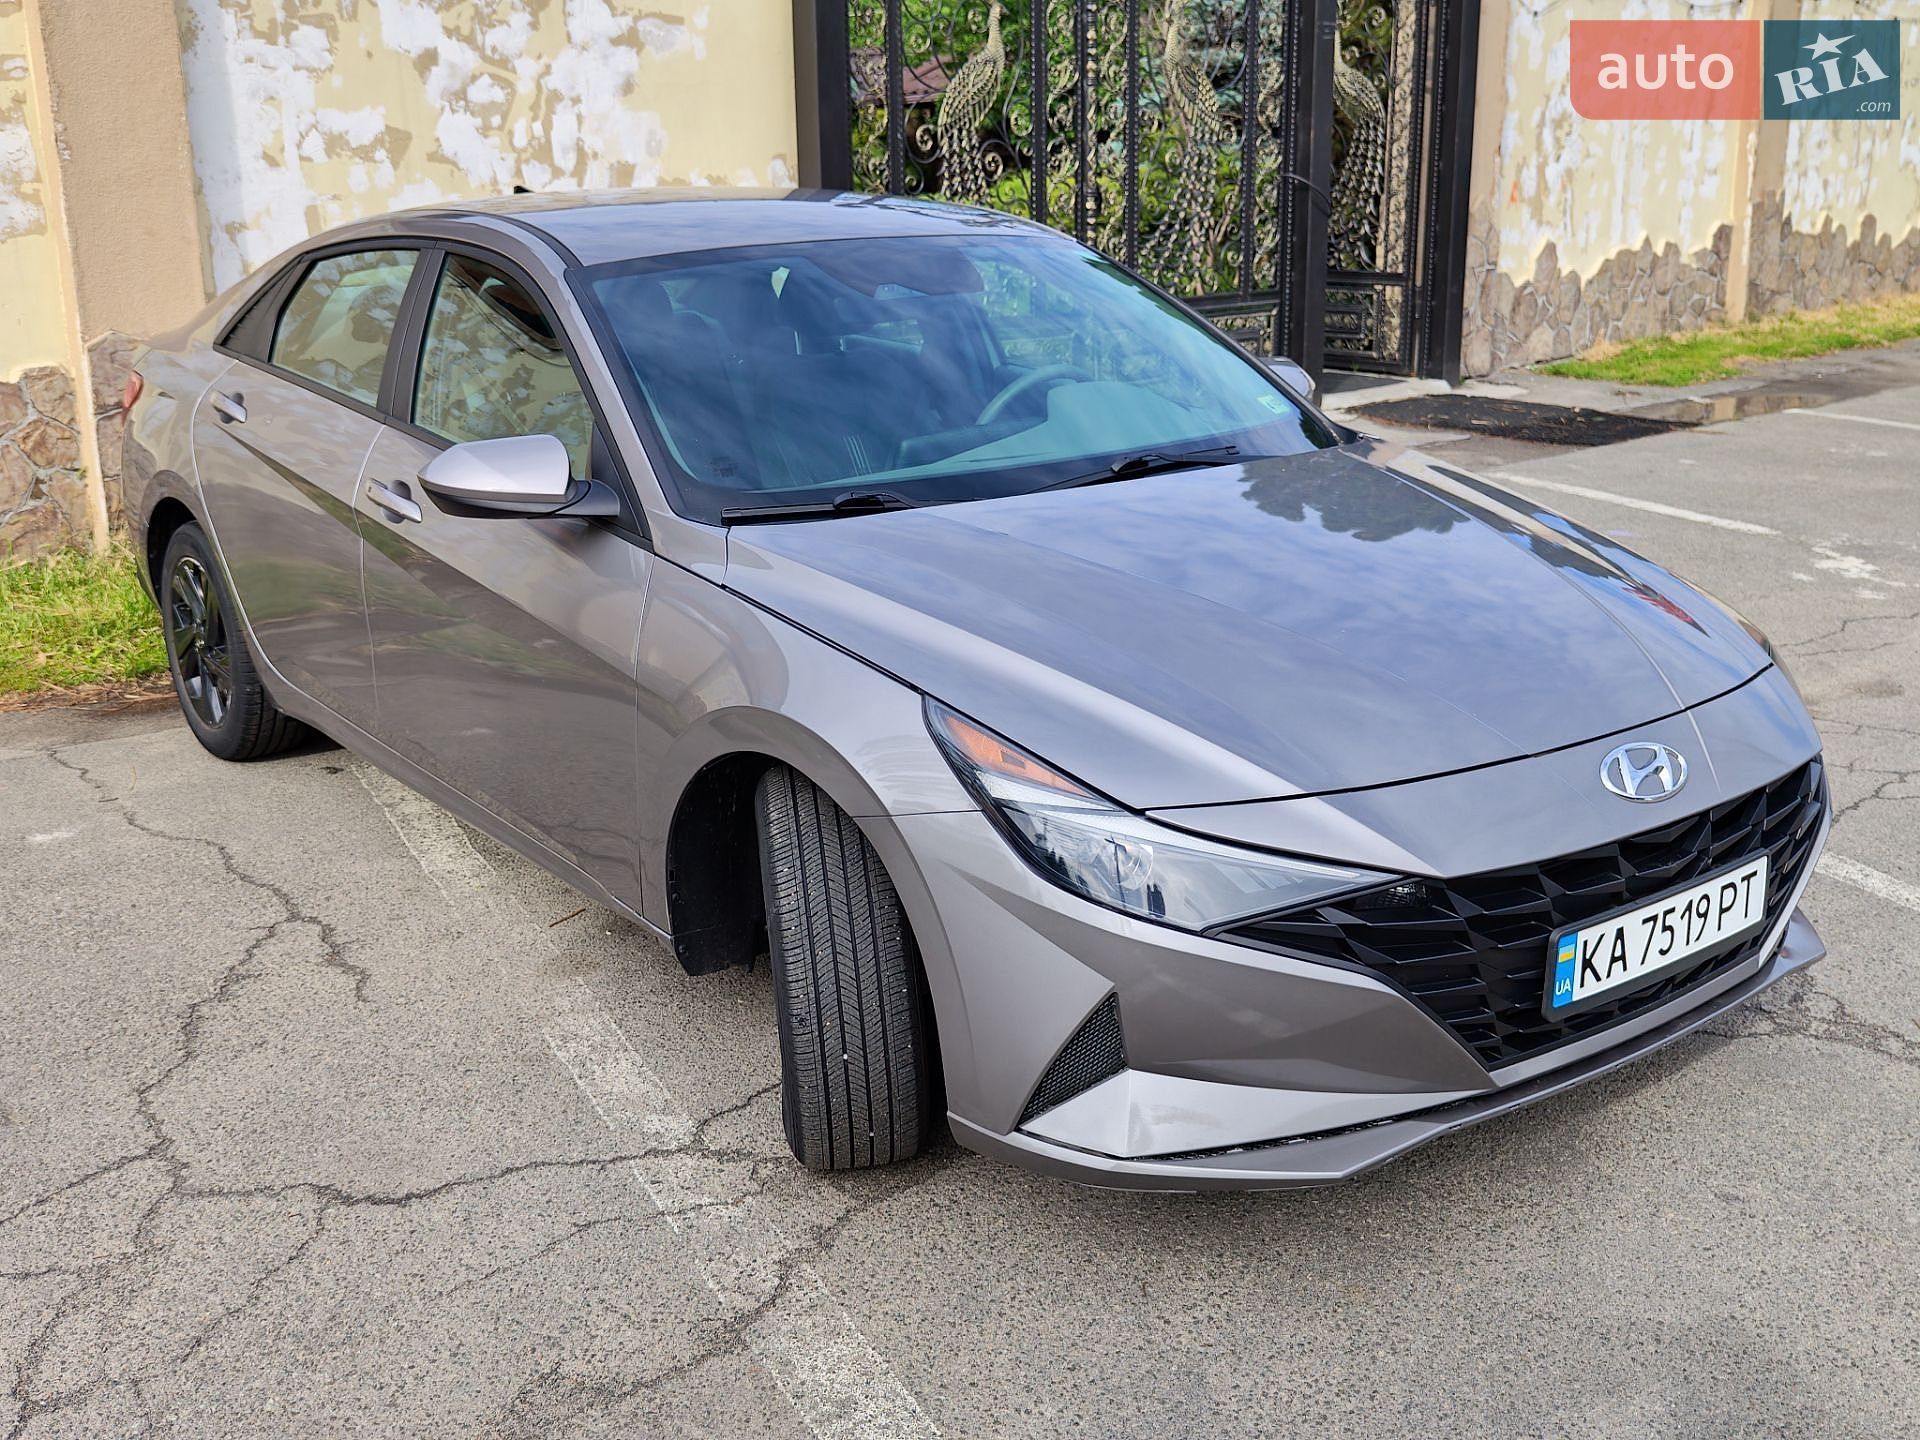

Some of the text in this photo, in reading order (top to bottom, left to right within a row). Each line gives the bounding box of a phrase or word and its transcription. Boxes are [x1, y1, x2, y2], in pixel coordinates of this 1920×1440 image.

[1579, 870, 1757, 988] KA 7519 PT
[1555, 978, 1571, 995] UA
